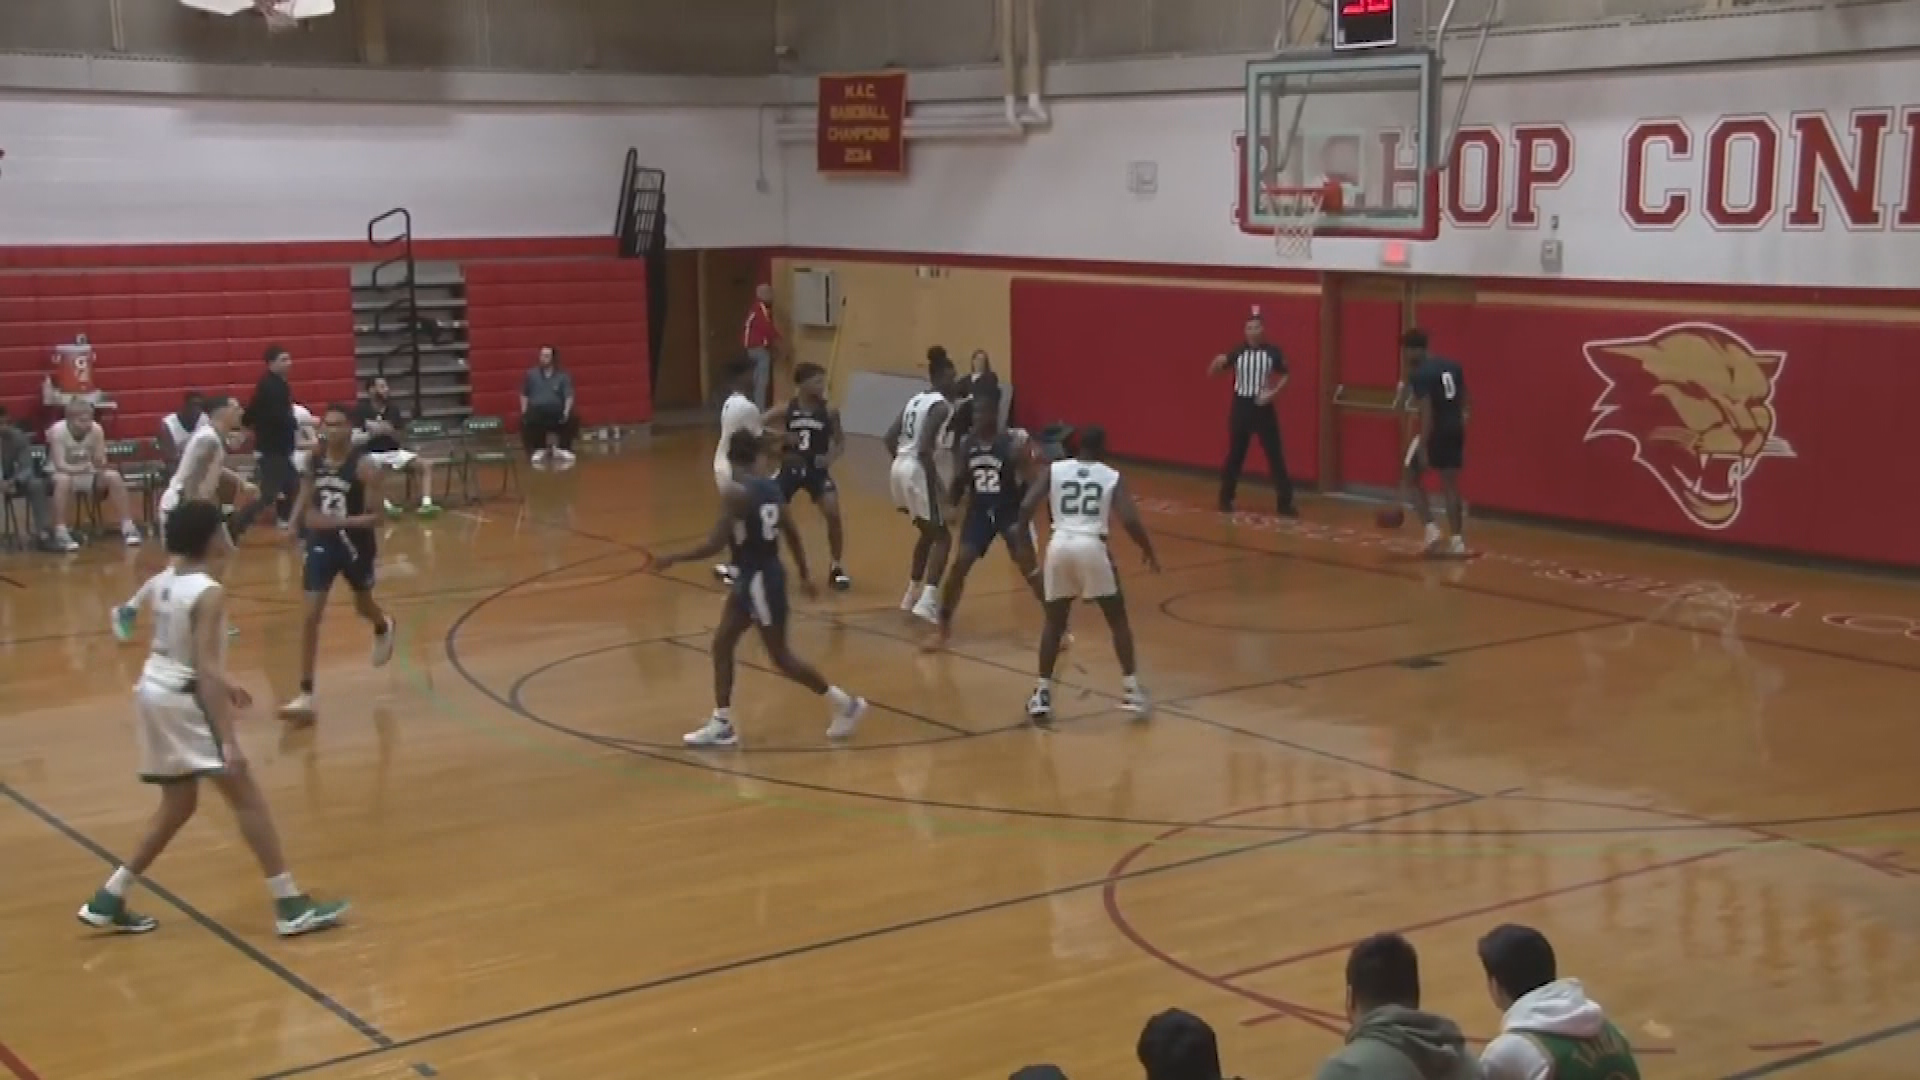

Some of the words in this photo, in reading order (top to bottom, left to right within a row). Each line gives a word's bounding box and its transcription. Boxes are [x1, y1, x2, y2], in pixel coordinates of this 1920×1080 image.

[1618, 105, 1920, 232] CON
[1441, 371, 1456, 400] 0
[798, 430, 811, 451] 3
[973, 469, 1001, 493] 22
[1060, 480, 1103, 517] 22
